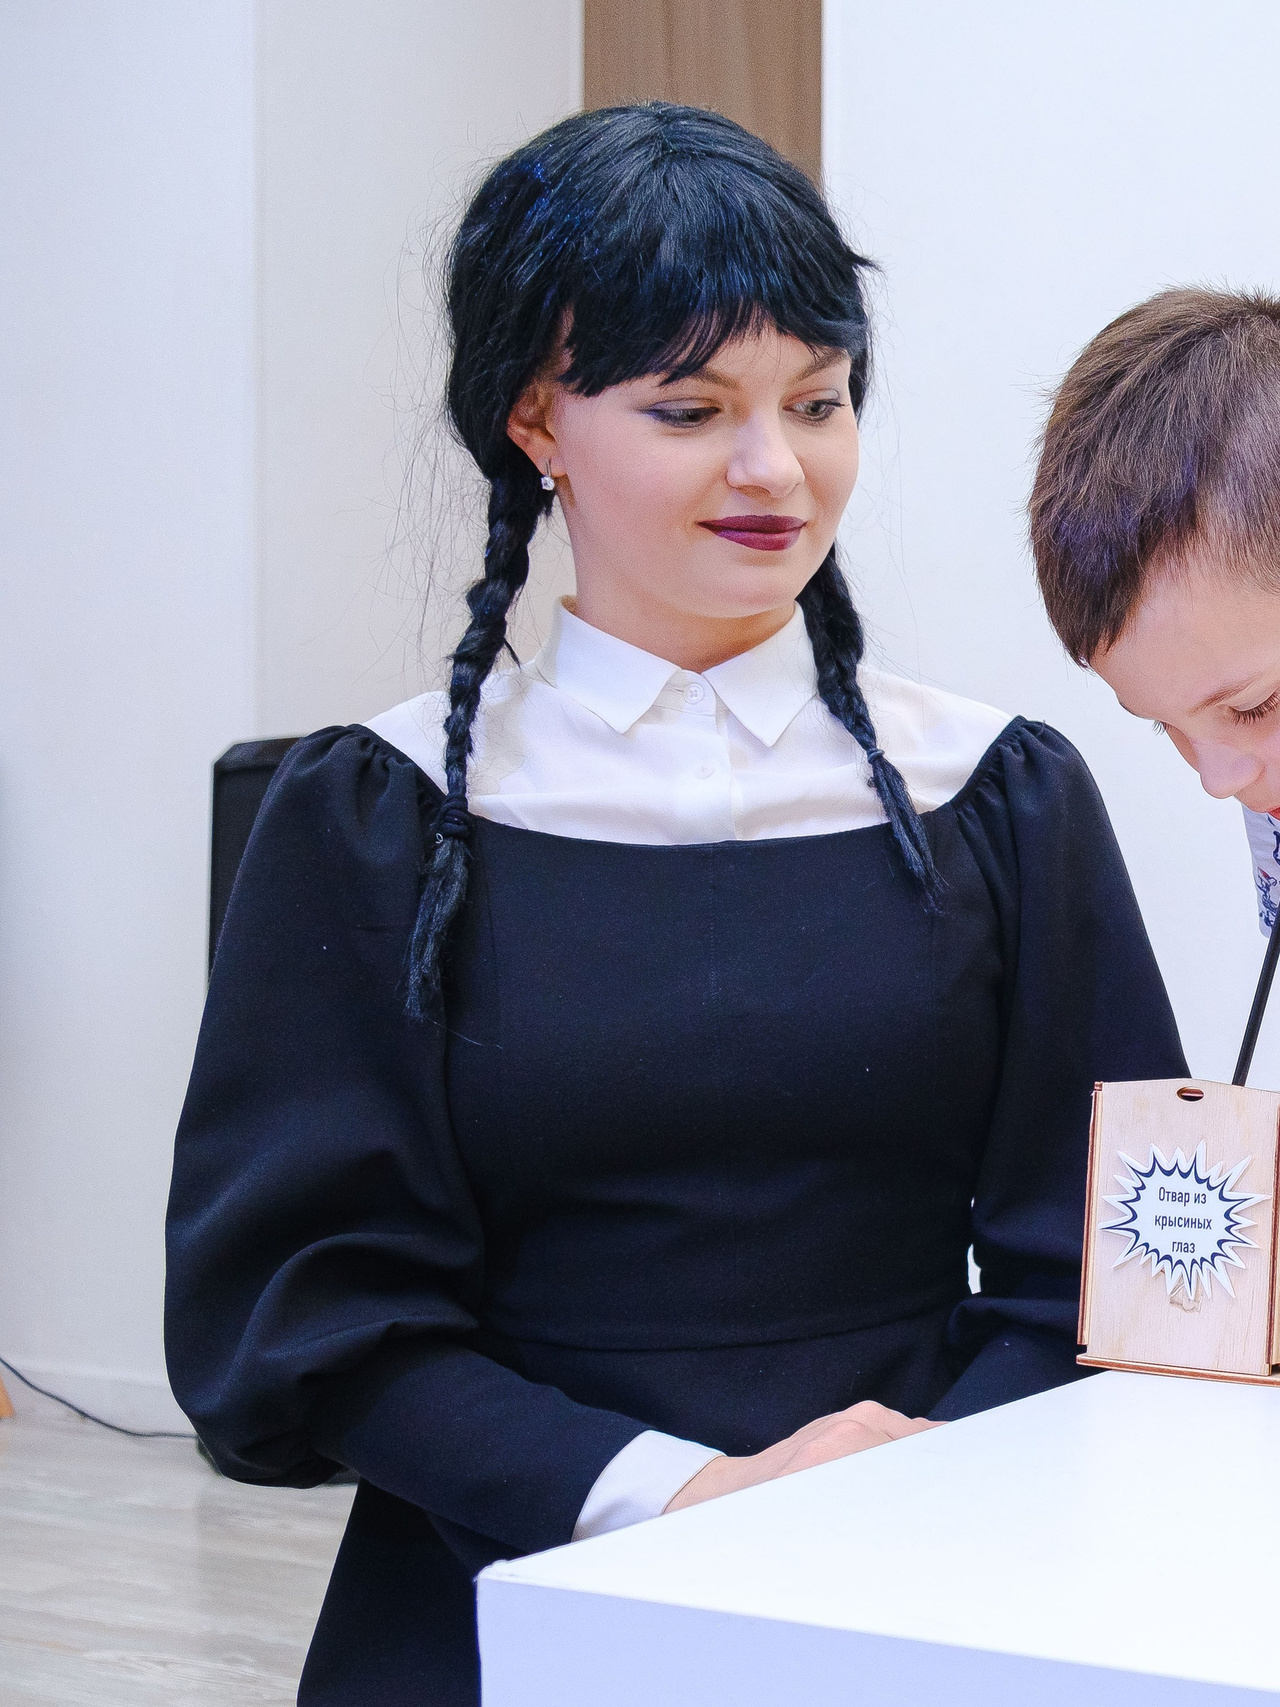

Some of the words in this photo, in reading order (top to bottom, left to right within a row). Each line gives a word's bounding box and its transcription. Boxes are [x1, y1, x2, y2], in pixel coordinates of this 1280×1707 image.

[1158, 1186, 1190, 1207] Отвар
[1193, 1192, 1207, 1205] из
[1154, 1214, 1213, 1231] крысиных
[1171, 1240, 1196, 1254] глаз
